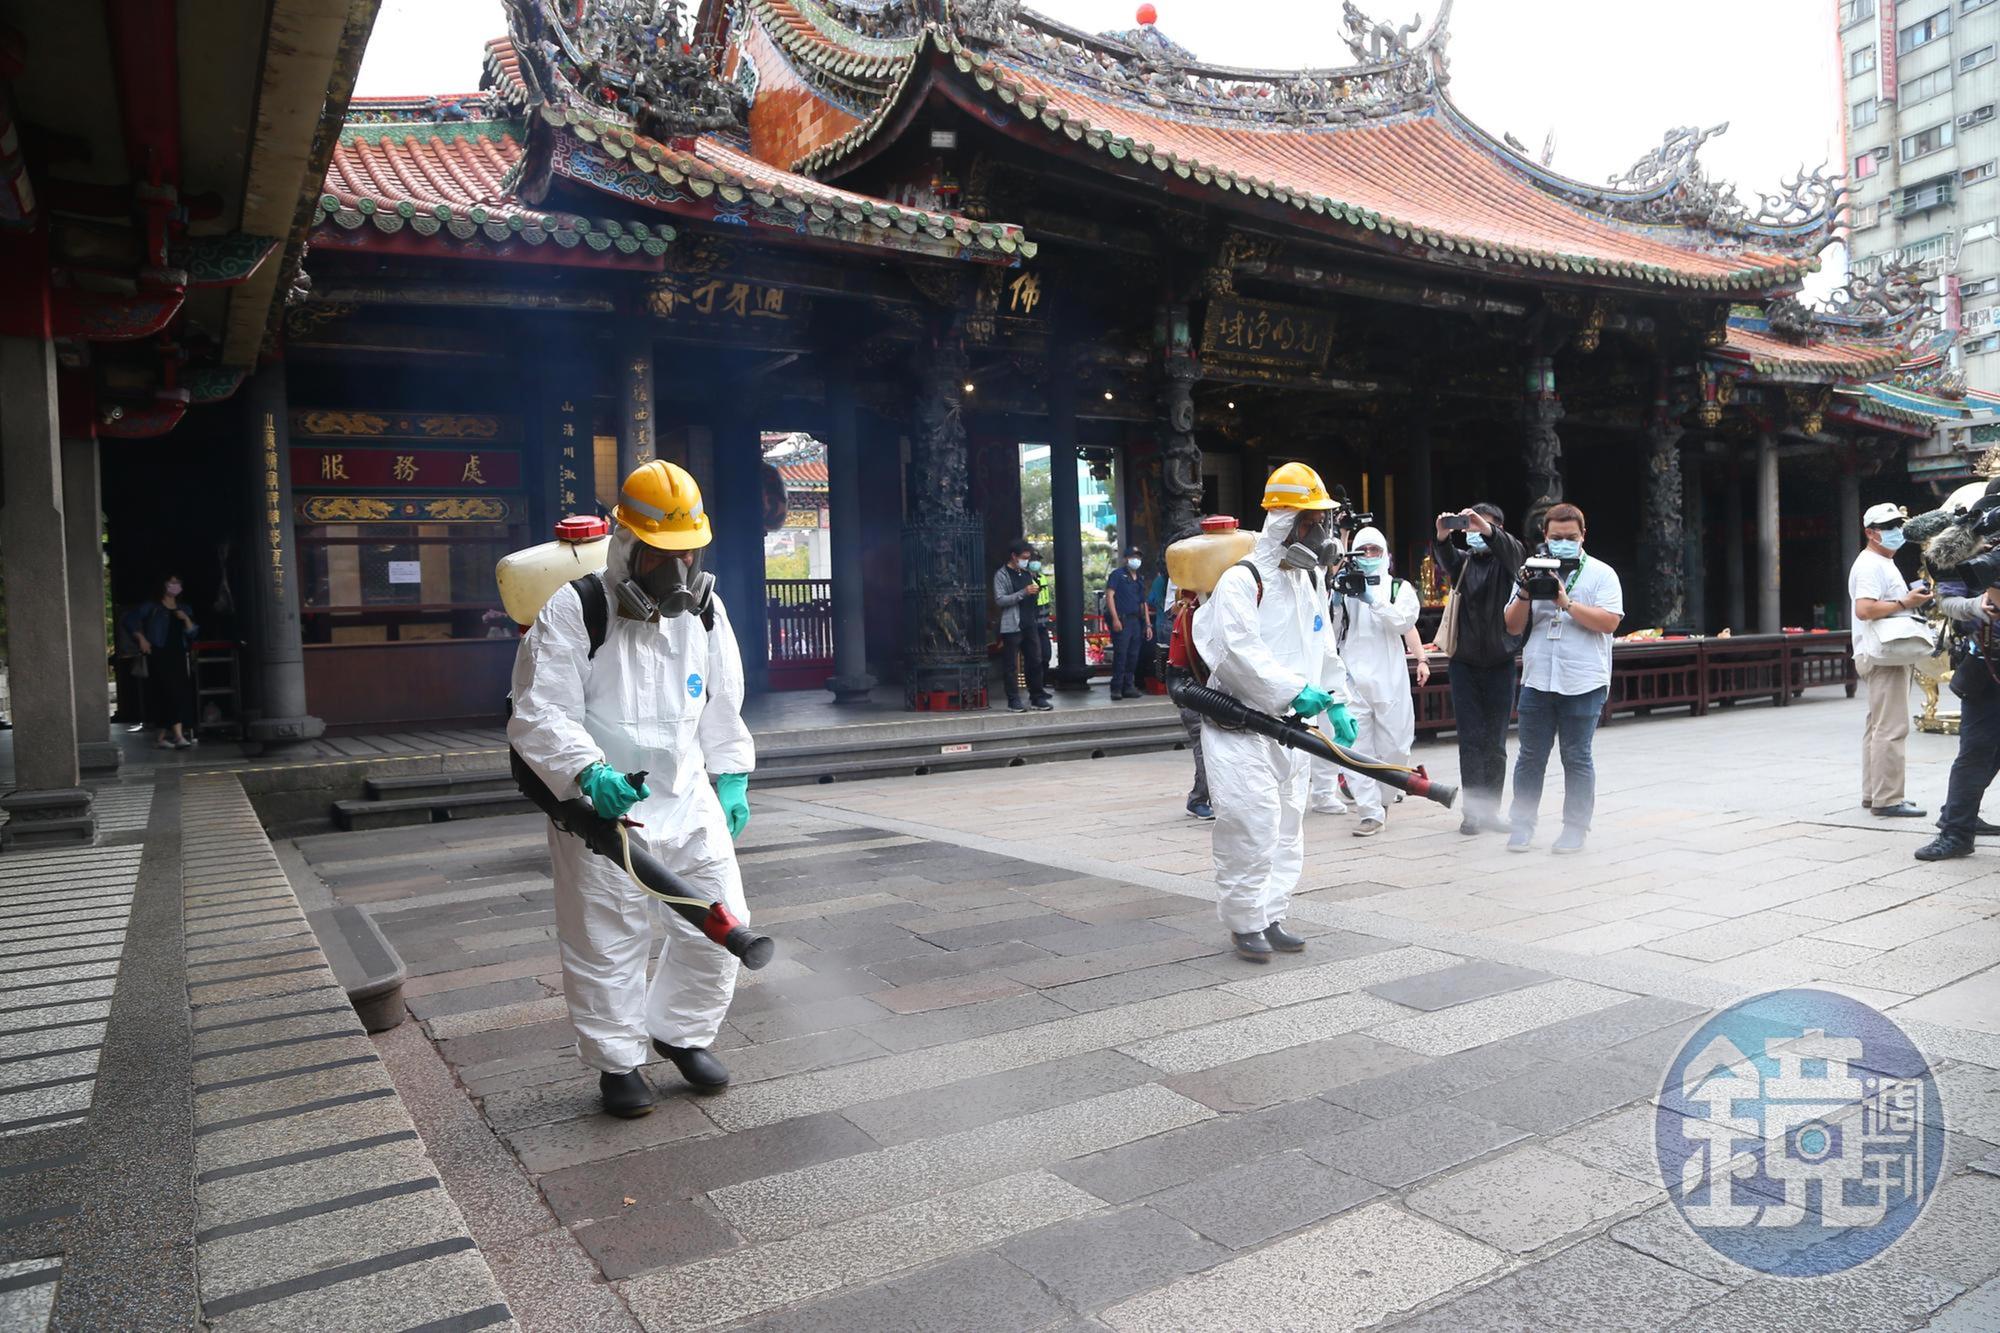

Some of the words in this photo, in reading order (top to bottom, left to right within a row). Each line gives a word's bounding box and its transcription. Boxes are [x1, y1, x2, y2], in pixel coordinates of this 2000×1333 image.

[1881, 31, 1893, 80] HOTEL
[1009, 271, 1041, 314] 佛
[320, 453, 488, 484] 服務處
